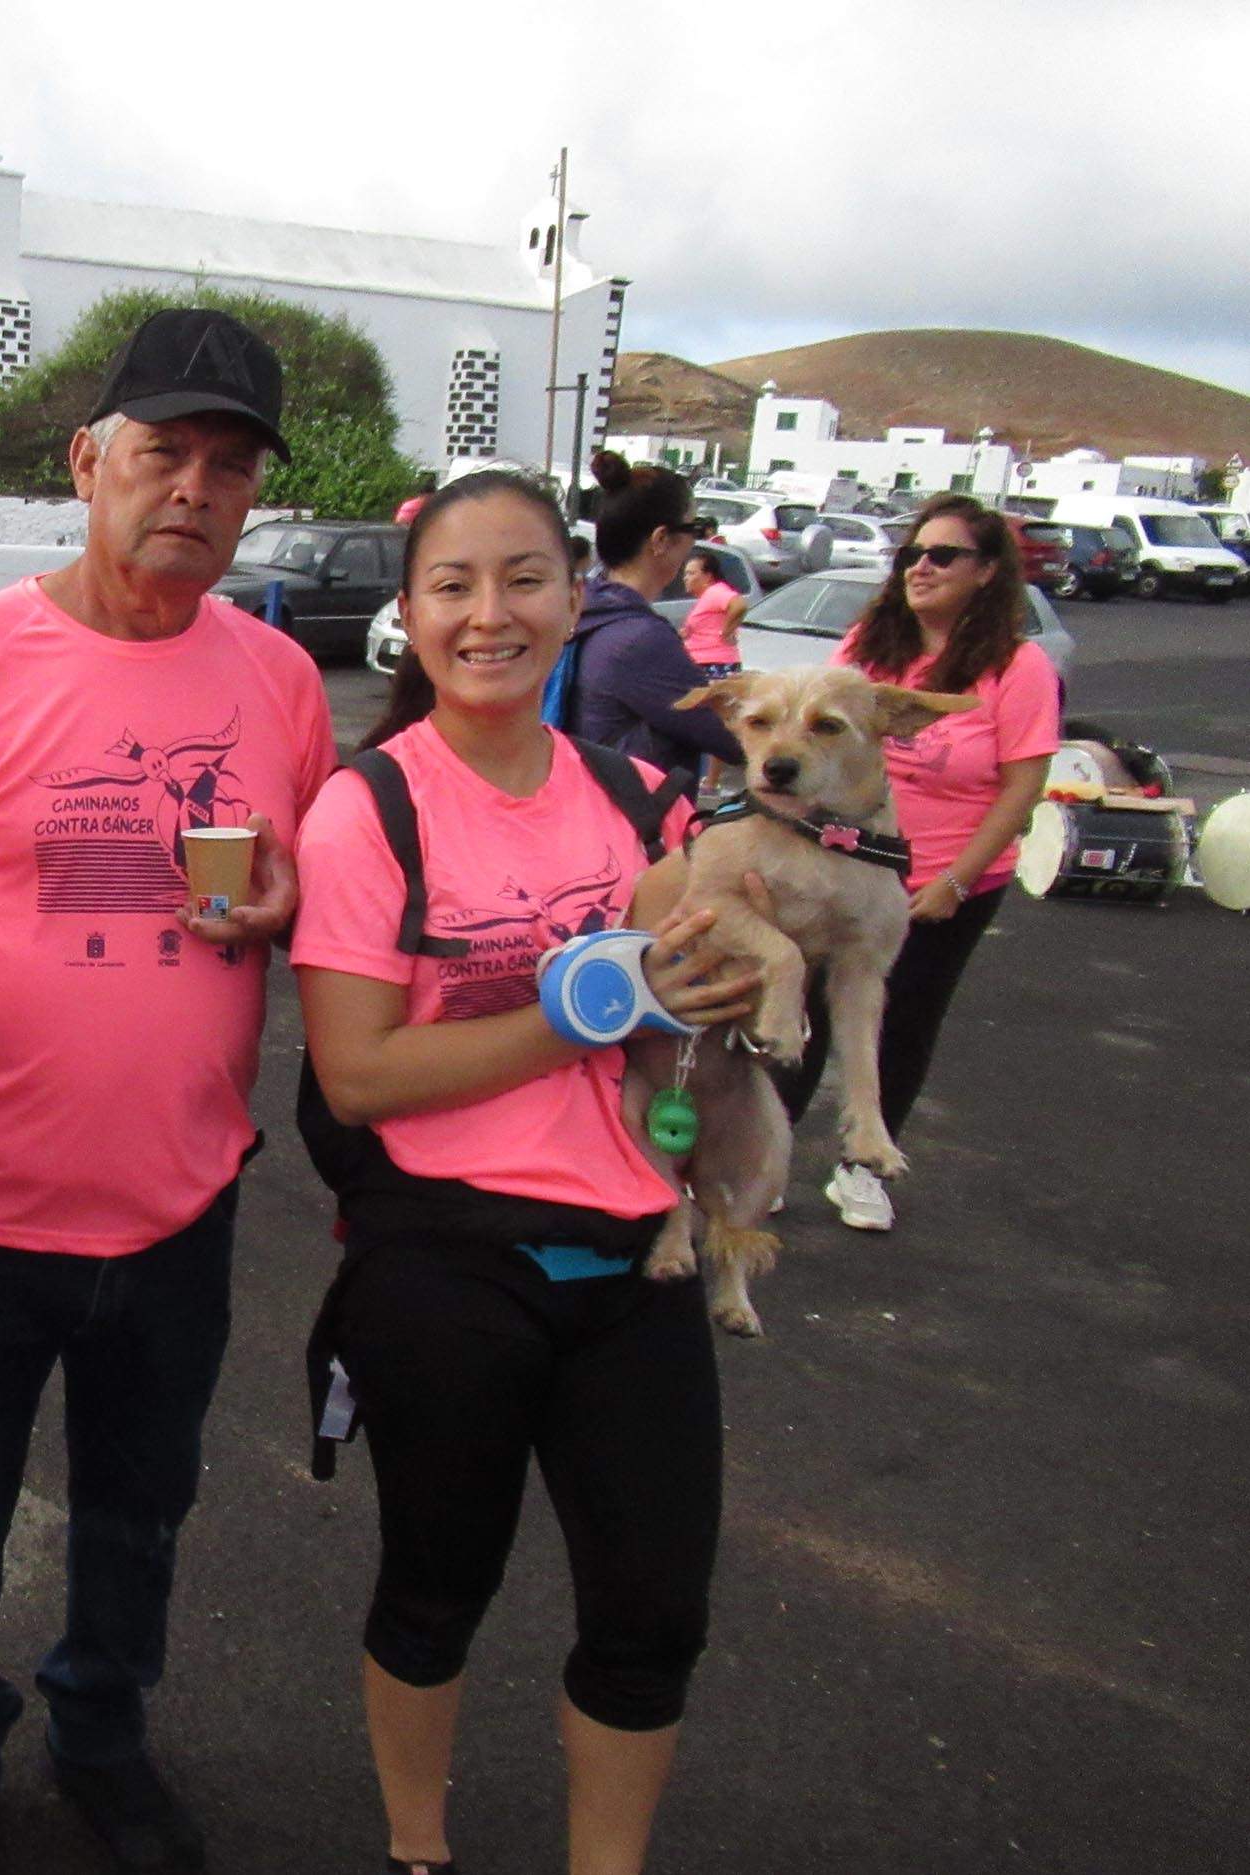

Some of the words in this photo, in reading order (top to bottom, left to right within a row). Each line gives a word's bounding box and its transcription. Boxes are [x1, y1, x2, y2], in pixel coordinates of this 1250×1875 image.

[52, 795, 140, 813] CAMINAMOS
[34, 818, 99, 836] CONTRA
[438, 959, 504, 979] CONTRA
